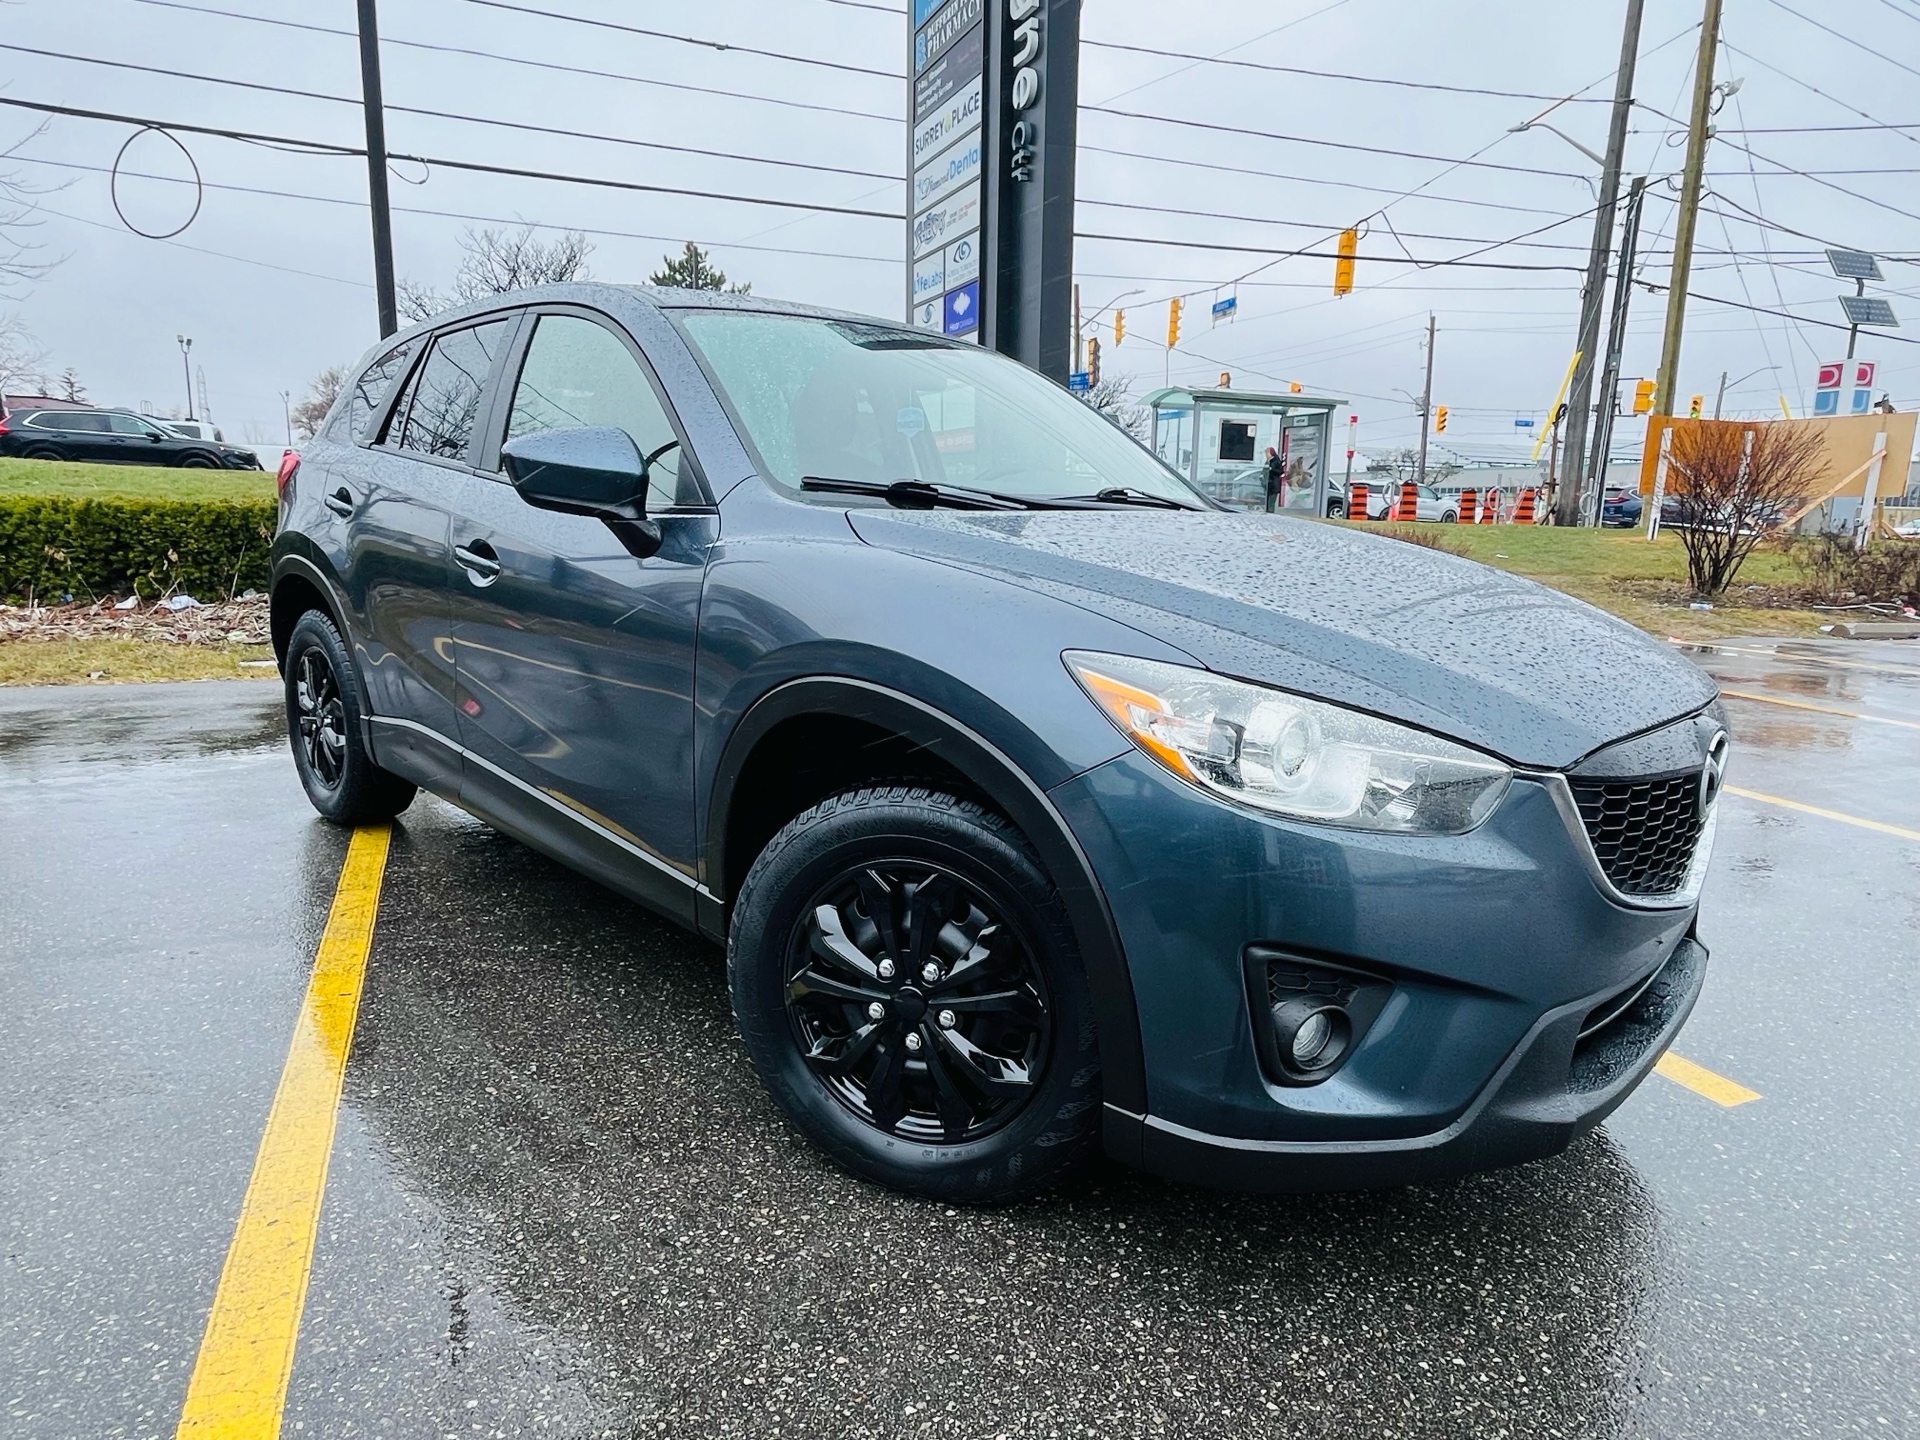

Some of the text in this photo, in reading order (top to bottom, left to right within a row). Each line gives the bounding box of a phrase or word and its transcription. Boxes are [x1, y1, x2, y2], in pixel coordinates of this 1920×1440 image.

[927, 0, 981, 59] PHARMACY
[915, 90, 980, 155] SURREY PLACE
[912, 271, 943, 295] LifeLabs
